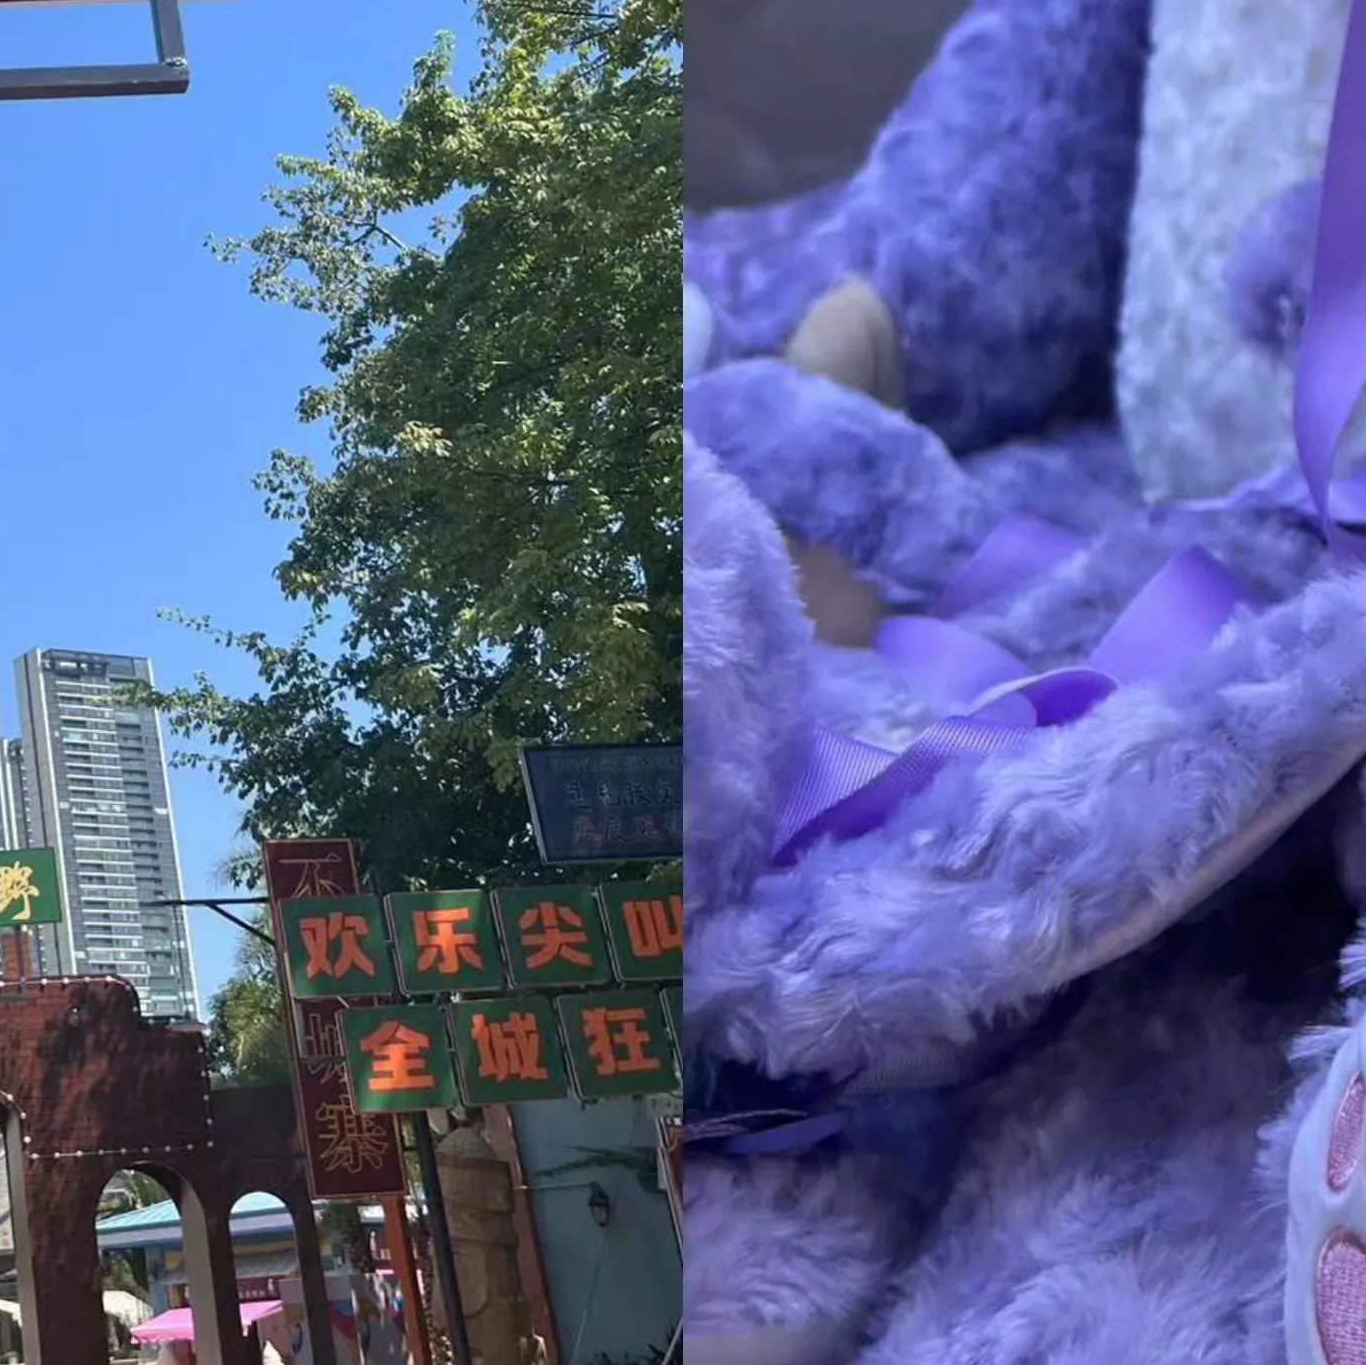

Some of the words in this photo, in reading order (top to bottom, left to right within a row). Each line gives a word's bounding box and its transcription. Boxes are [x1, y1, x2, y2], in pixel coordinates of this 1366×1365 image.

[298, 896, 683, 982] 欢乐尖叫
[360, 1007, 661, 1092] 全城狂
